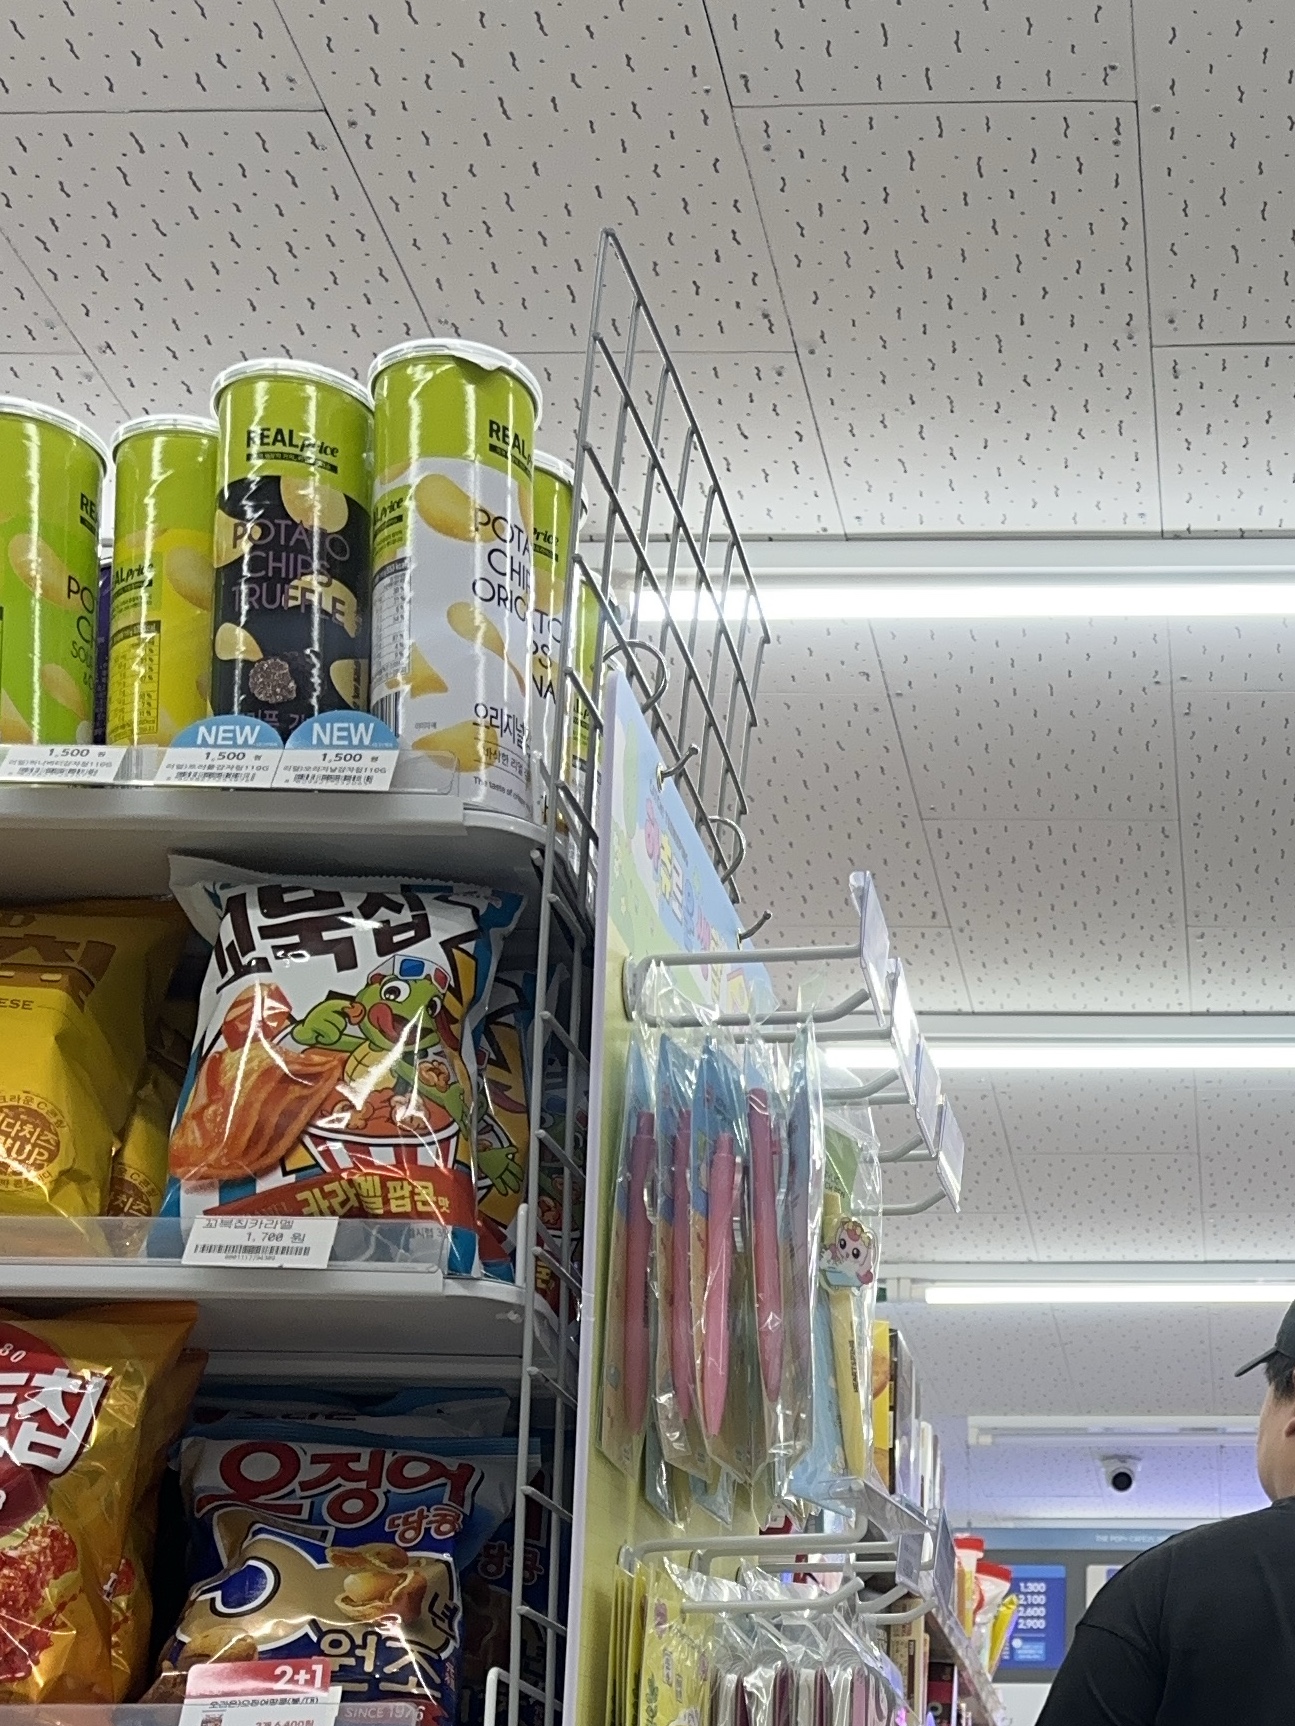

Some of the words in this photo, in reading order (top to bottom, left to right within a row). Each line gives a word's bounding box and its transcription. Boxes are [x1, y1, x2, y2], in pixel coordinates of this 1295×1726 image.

[246, 426, 299, 450] REAL
[231, 519, 351, 562] POTATO
[246, 551, 334, 589] CHIPS
[231, 583, 348, 628] TRUFFLE
[197, 725, 262, 747] NEW
[312, 722, 375, 746] NEW
[48, 748, 91, 758] 1,500
[204, 751, 247, 762] 1,500
[321, 752, 364, 763] 1,500
[197, 1438, 480, 1531] 오징어
[385, 1504, 464, 1548] 땅콩
[273, 1662, 326, 1690] 2+1
[344, 1707, 384, 1719] SINCE
